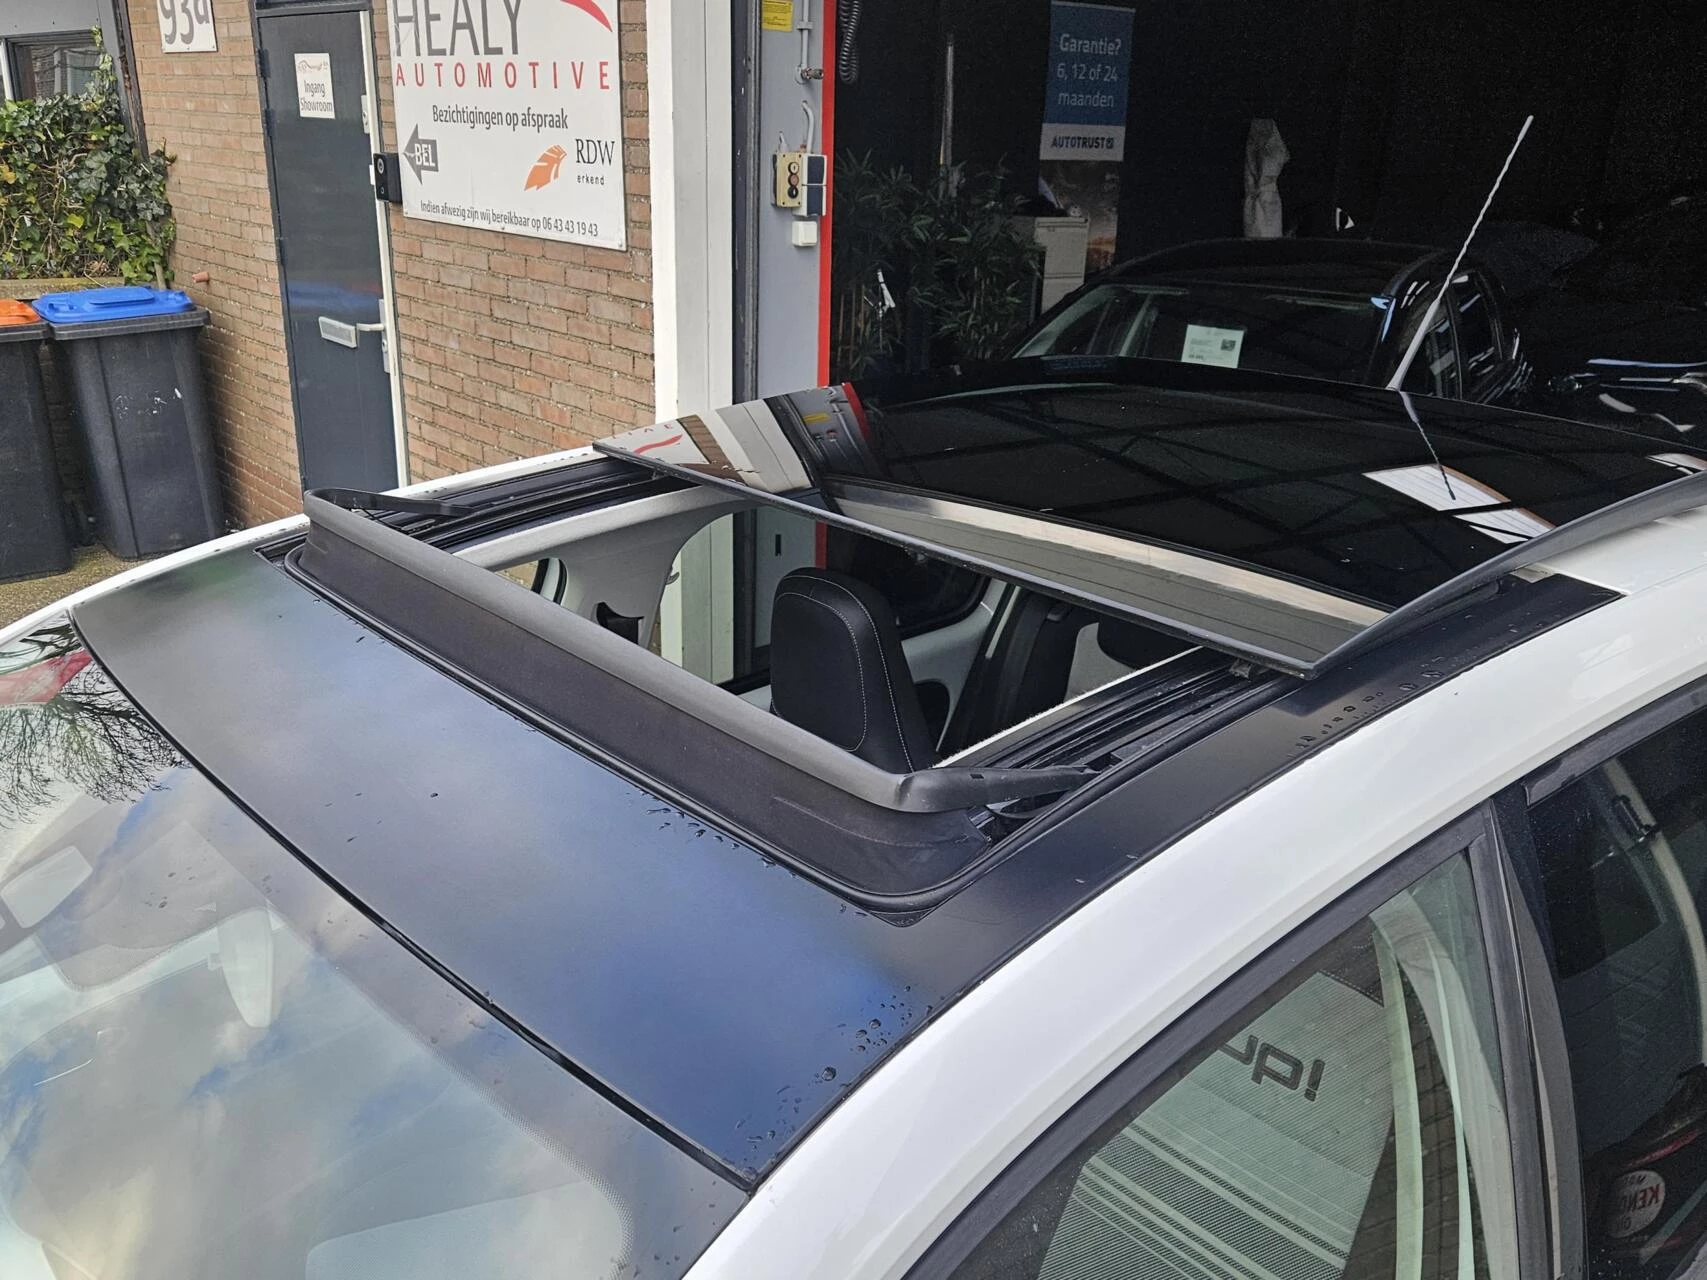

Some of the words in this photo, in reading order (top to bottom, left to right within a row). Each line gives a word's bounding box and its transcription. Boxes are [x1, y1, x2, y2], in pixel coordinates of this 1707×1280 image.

[393, 0, 521, 57] HEALY
[1060, 33, 1121, 56] Garantie?
[395, 61, 610, 90] AUTOMOTIVE
[1057, 62, 1068, 80] 6,
[1072, 63, 1086, 80] 12
[1089, 64, 1102, 80] of
[1103, 65, 1118, 82] 24
[303, 79, 326, 98] Ingang
[1057, 91, 1115, 108] maanden
[300, 97, 333, 113] Showroom
[432, 104, 504, 131] Bezichtigingen
[505, 111, 519, 132] op
[521, 107, 569, 134] afspraak
[575, 138, 615, 166] RDW
[1051, 135, 1105, 149] AUTOTRUST
[414, 143, 436, 167] BEL
[577, 173, 605, 186] erkend
[420, 200, 440, 214] Indien
[441, 202, 466, 221] afwezig
[467, 206, 479, 223] zijn
[480, 208, 492, 224] wij
[492, 209, 530, 228] bereikbaar
[531, 217, 542, 232] op
[542, 216, 552, 231] 06
[553, 218, 563, 233] 43
[565, 219, 574, 235] 43
[577, 221, 587, 236] 19
[588, 223, 598, 237] 43
